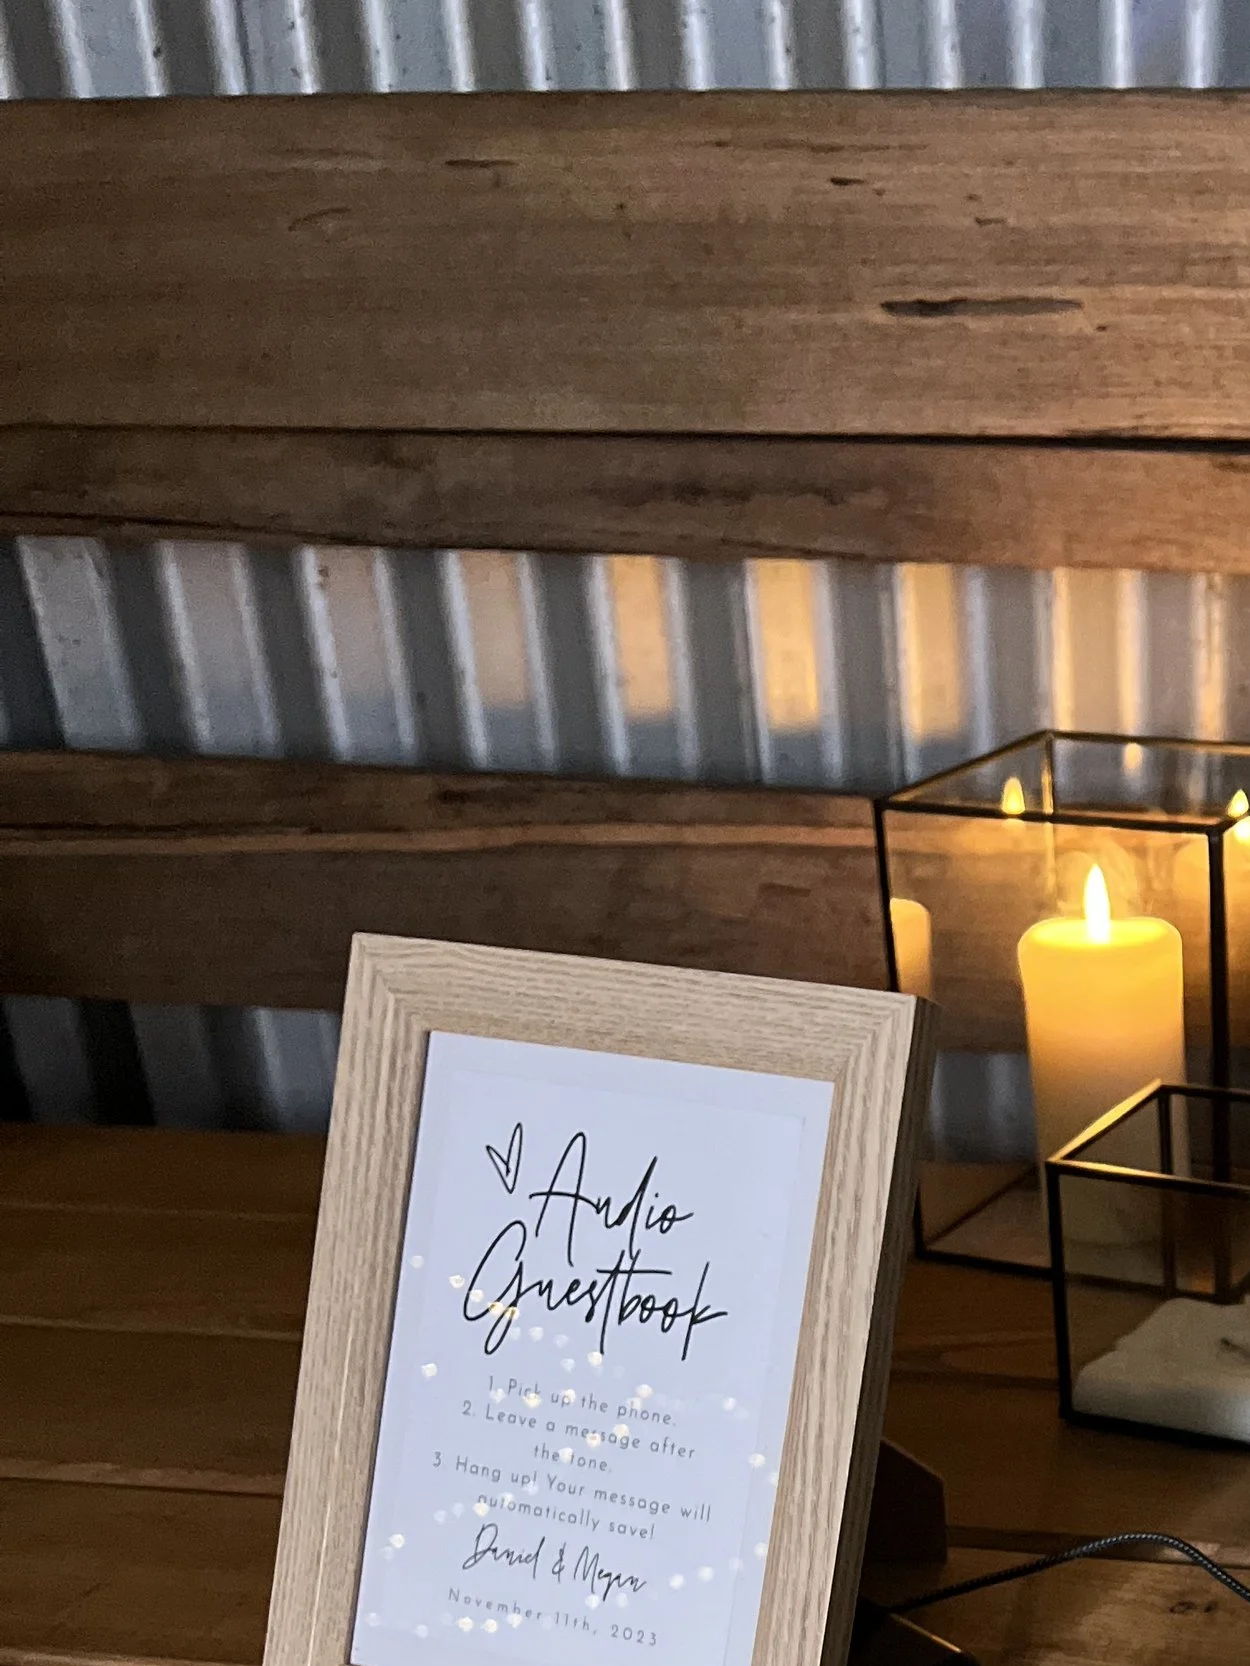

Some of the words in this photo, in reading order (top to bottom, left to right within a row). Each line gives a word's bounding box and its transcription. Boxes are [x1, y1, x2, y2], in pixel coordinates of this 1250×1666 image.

[528, 1131, 694, 1268] Audio
[463, 1219, 728, 1362] Guestbook
[507, 1377, 541, 1399] Pick
[551, 1392, 573, 1408] up
[581, 1393, 608, 1413] the
[485, 1403, 537, 1428] Leave
[546, 1420, 556, 1432] a
[565, 1424, 640, 1450] mesage
[650, 1435, 696, 1459] after
[534, 1442, 560, 1462] the
[455, 1455, 501, 1483] Hang
[547, 1473, 586, 1497] Your
[594, 1488, 671, 1516] message
[680, 1502, 712, 1523] will
[477, 1494, 600, 1532] automatically
[609, 1523, 656, 1541] save!
[461, 1522, 546, 1581] Daniel
[551, 1541, 567, 1584] &
[573, 1545, 648, 1602] Megan
[448, 1587, 543, 1620] November
[554, 1611, 598, 1636] 11th,
[610, 1623, 658, 1647] 2023
